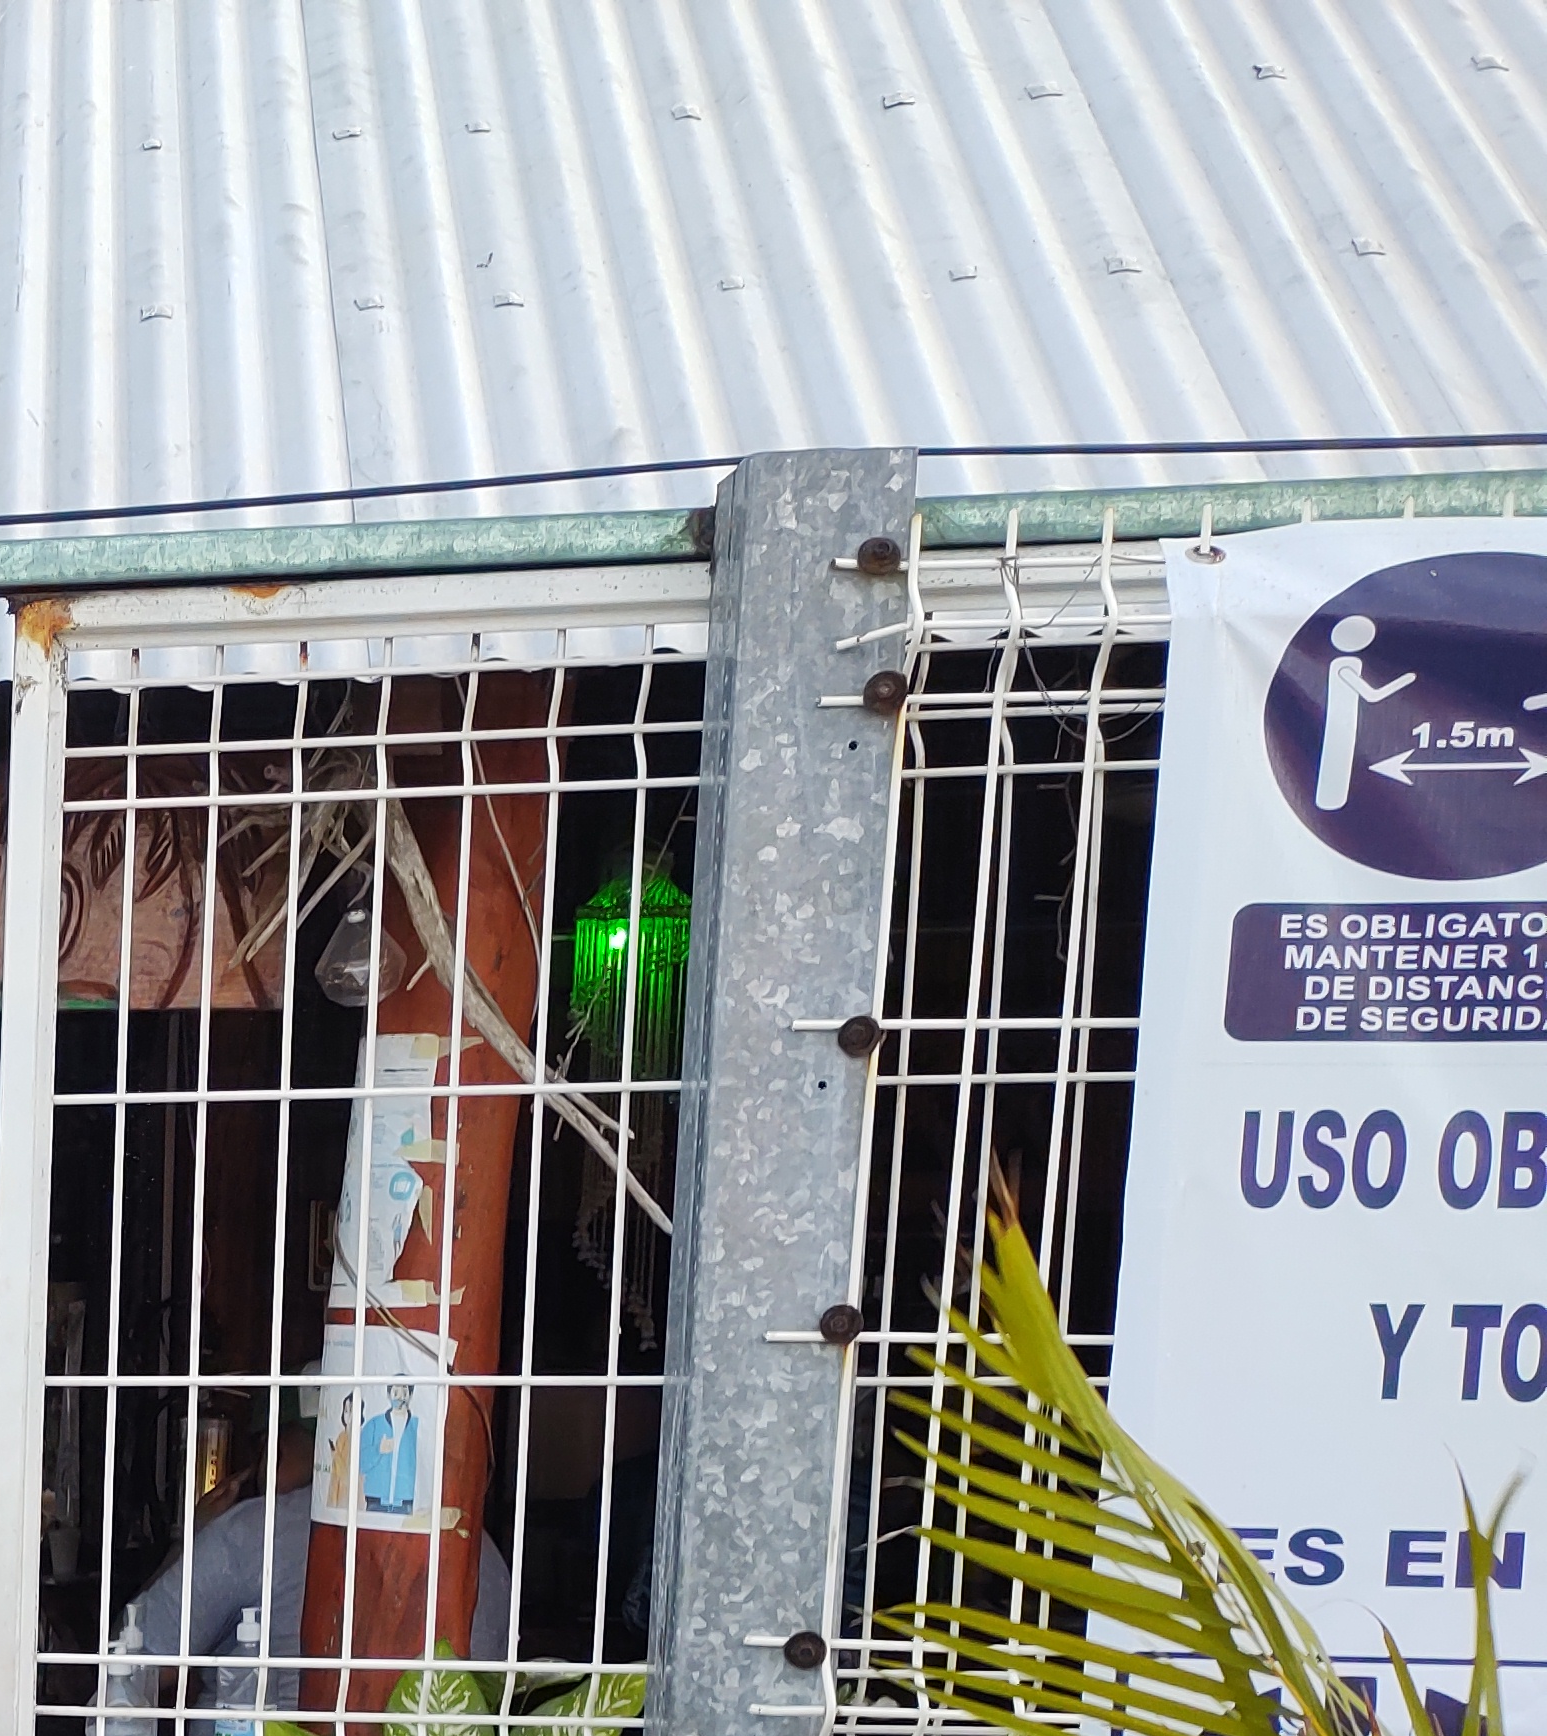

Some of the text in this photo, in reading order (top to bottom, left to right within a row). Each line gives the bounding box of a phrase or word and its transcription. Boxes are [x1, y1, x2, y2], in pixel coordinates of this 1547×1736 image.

[1411, 720, 1515, 749] 1.5m
[1279, 911, 1547, 939] ES OBLIGATO
[1283, 943, 1508, 970] MANTENER
[1304, 974, 1356, 1001] DE
[1295, 1005, 1547, 1032] DE SEGURID
[1239, 1108, 1547, 1210] USO OB
[1368, 1302, 1547, 1403] Y TO
[1384, 1529, 1526, 1590] EN
